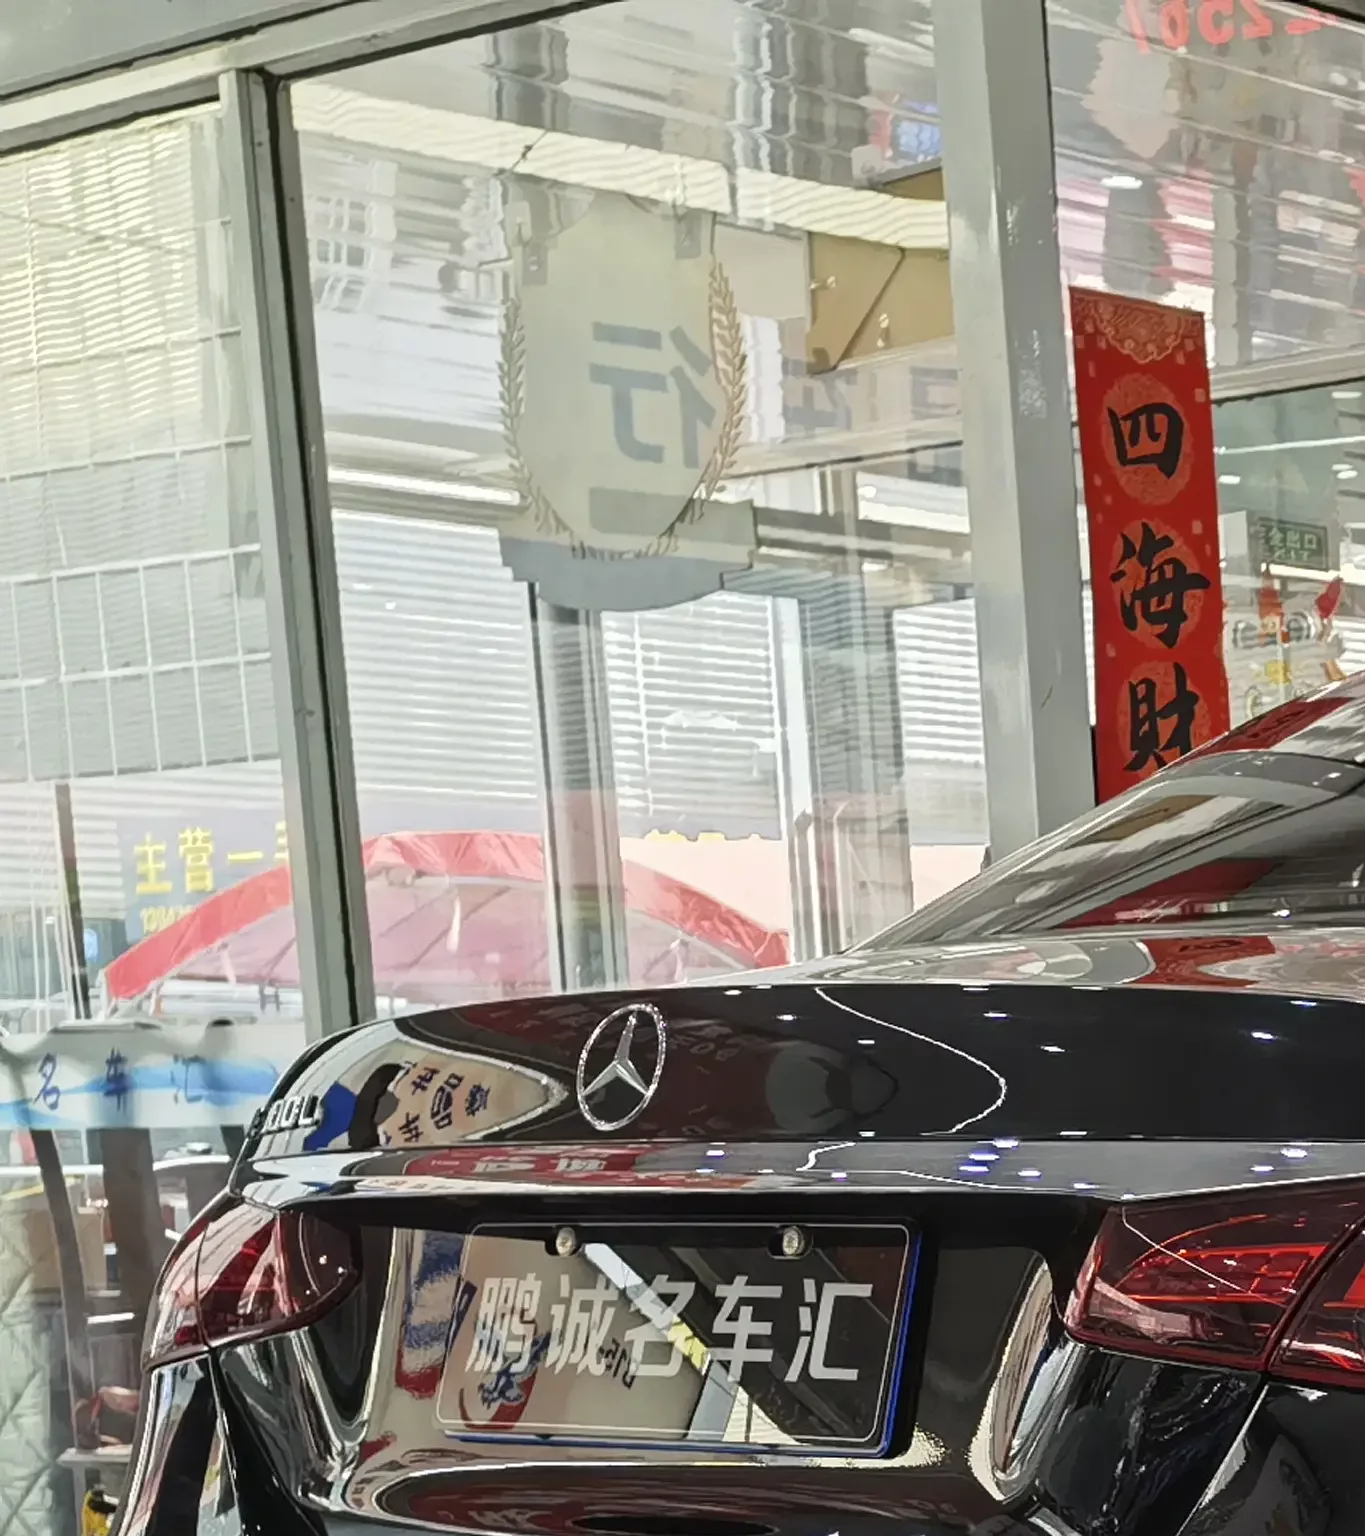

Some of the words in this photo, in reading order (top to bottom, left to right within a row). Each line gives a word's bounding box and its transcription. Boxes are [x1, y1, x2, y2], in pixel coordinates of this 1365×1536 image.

[464, 1272, 874, 1385] 鹏诚名车汇
